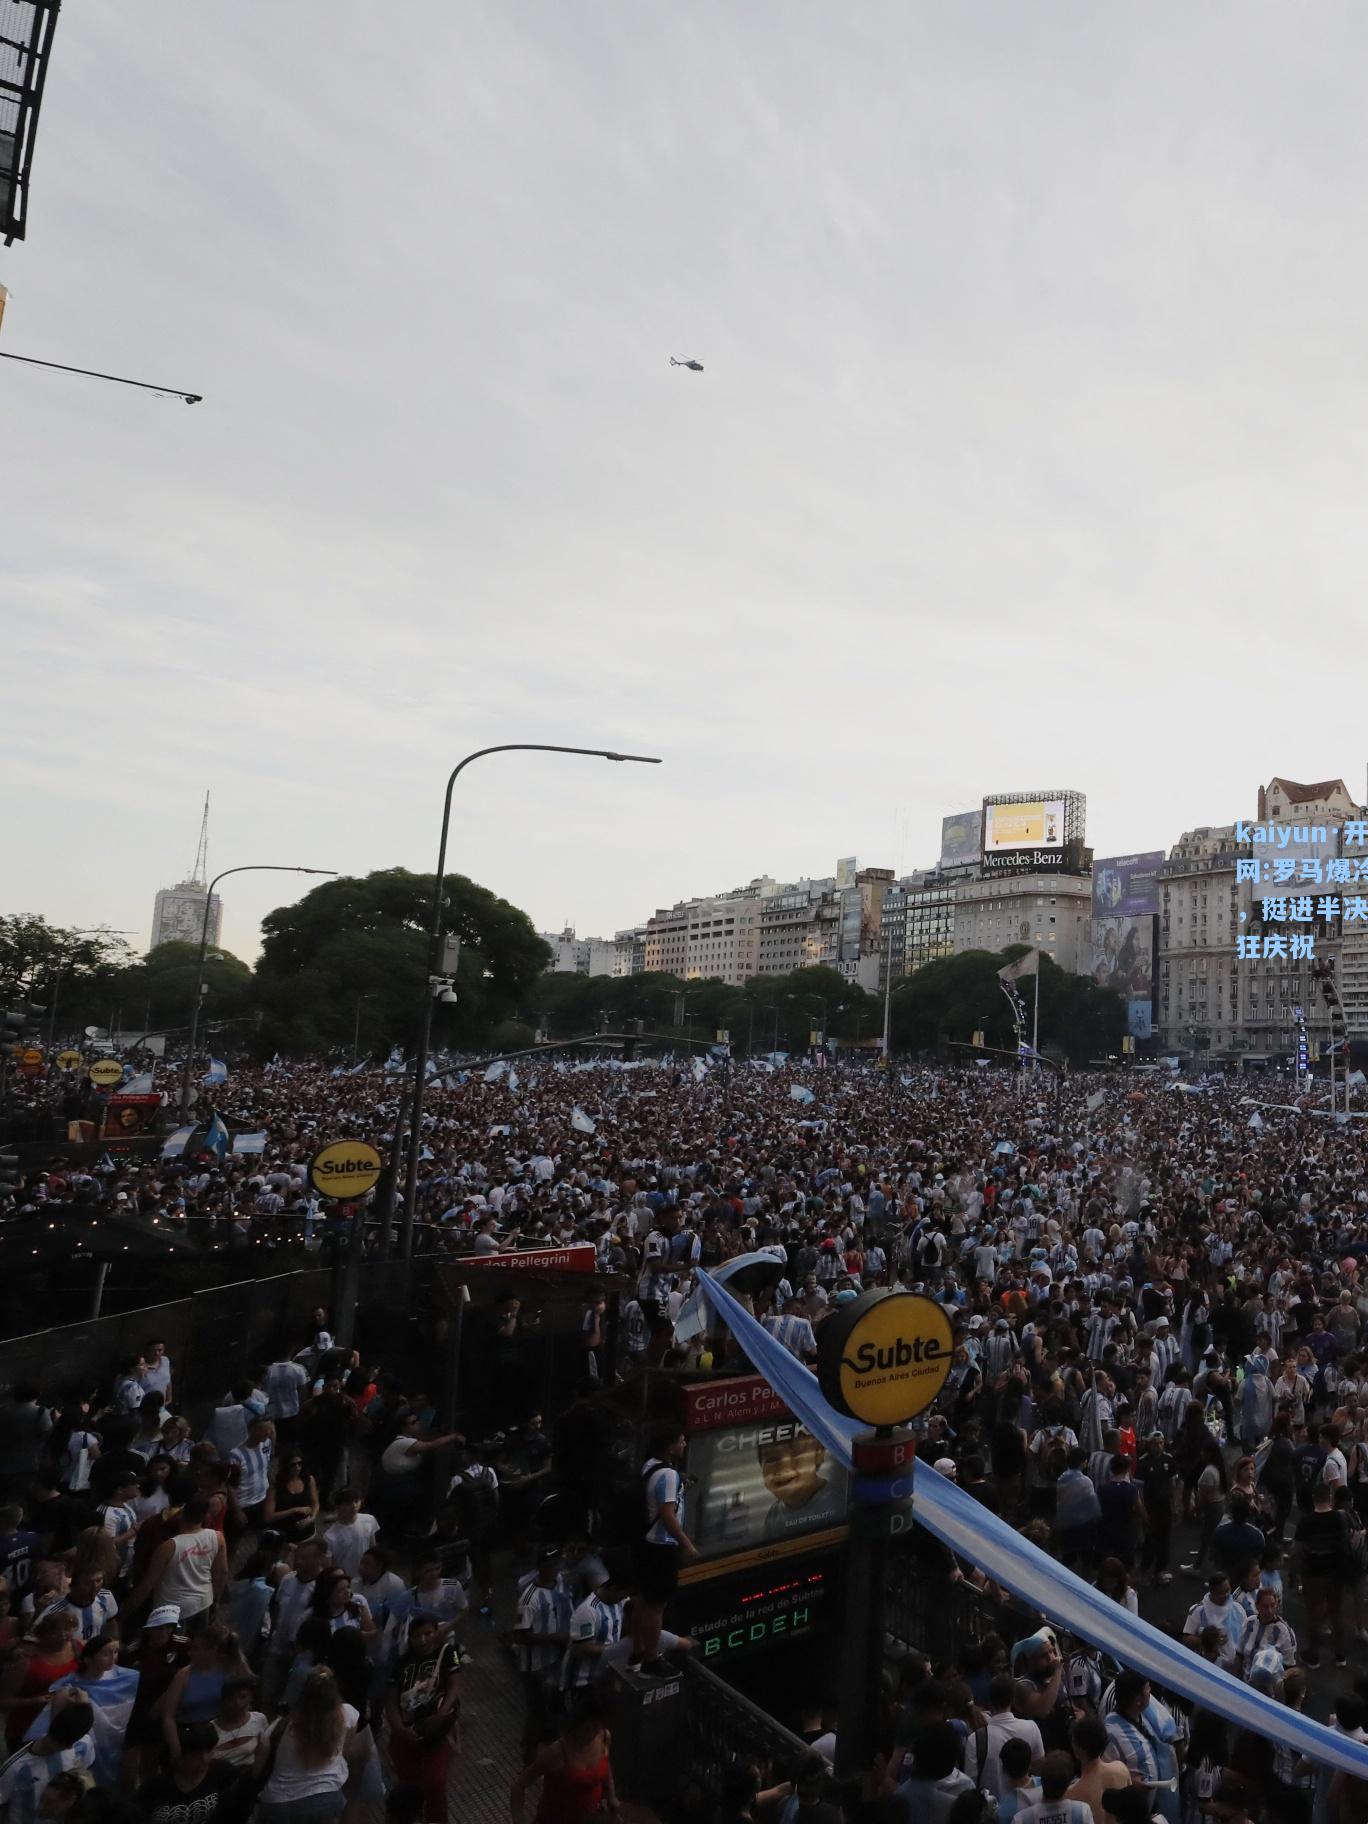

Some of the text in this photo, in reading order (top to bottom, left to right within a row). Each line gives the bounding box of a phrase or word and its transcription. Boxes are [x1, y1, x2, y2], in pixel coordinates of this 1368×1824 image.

[983, 851, 1063, 867] Mercedes-Benz
[322, 1159, 376, 1174] Subte
[511, 1253, 570, 1268] Pellegrini
[847, 1337, 950, 1374] Subte
[855, 1365, 940, 1389] Buenos Aires Ciudad
[695, 1392, 747, 1411] Carlos
[728, 1408, 751, 1417] Alem
[893, 1445, 905, 1465] B
[890, 1479, 903, 1498] C
[890, 1514, 904, 1535] D
[690, 1618, 728, 1636] Estado
[730, 1612, 743, 1624] de
[746, 1607, 755, 1619] la
[757, 1601, 775, 1616] red
[776, 1597, 790, 1609] de
[704, 1636, 722, 1656] B
[727, 1629, 745, 1648] C
[750, 1622, 767, 1641] D
[772, 1615, 788, 1633] E
[793, 1607, 809, 1627] H
[1039, 1813, 1067, 1824] MESSI
